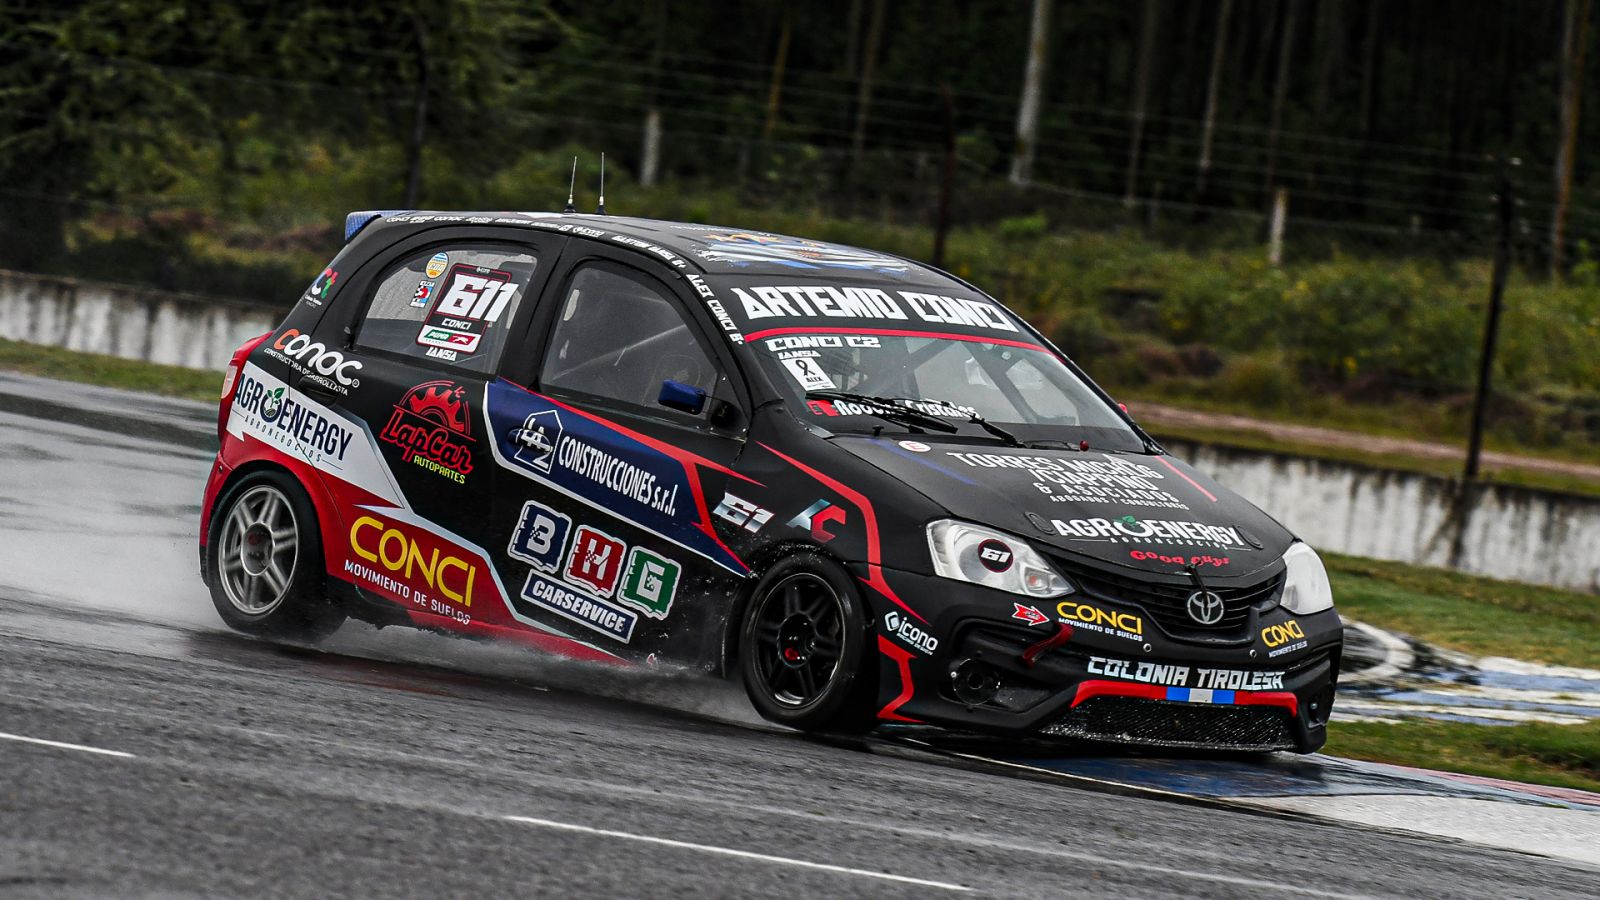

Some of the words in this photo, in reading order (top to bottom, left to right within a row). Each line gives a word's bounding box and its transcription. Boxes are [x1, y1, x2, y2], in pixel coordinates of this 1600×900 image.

[436, 273, 519, 323] 611
[686, 273, 715, 298] ALEX
[706, 299, 738, 331] CONCI
[730, 286, 908, 321] ARTEMIO
[896, 290, 1019, 333] CONCI
[441, 317, 472, 331] CONCI
[764, 335, 844, 353] CONCI
[843, 335, 882, 348] C2
[234, 372, 354, 462] AGROENERGY
[413, 454, 467, 485] AUTOPARTES
[558, 435, 657, 506] CONSTRUCCIONES
[946, 452, 1064, 472] TORRES
[1032, 482, 1053, 494] &
[1060, 483, 1180, 503] ASOCIADOS
[1049, 495, 1110, 503] ABOGADOS
[1119, 498, 1190, 511] CONSULTORES
[713, 491, 775, 533] 61
[1050, 517, 1245, 547] AGROENERGY
[350, 516, 476, 608] CONCI
[980, 546, 1011, 563] 61
[344, 559, 410, 599] MOVIMIENTO
[413, 590, 428, 607] DE
[430, 598, 472, 625] SUELOS
[532, 580, 627, 633] CARSERVICE
[1056, 601, 1143, 635] CONCI
[1058, 617, 1103, 633] MOVIMIENTO
[1104, 627, 1115, 635] DE
[1116, 630, 1144, 642] SUELOS
[1261, 620, 1305, 648] CONCI
[1087, 655, 1191, 687] COLONIA
[1196, 668, 1287, 691] TIROLESA
